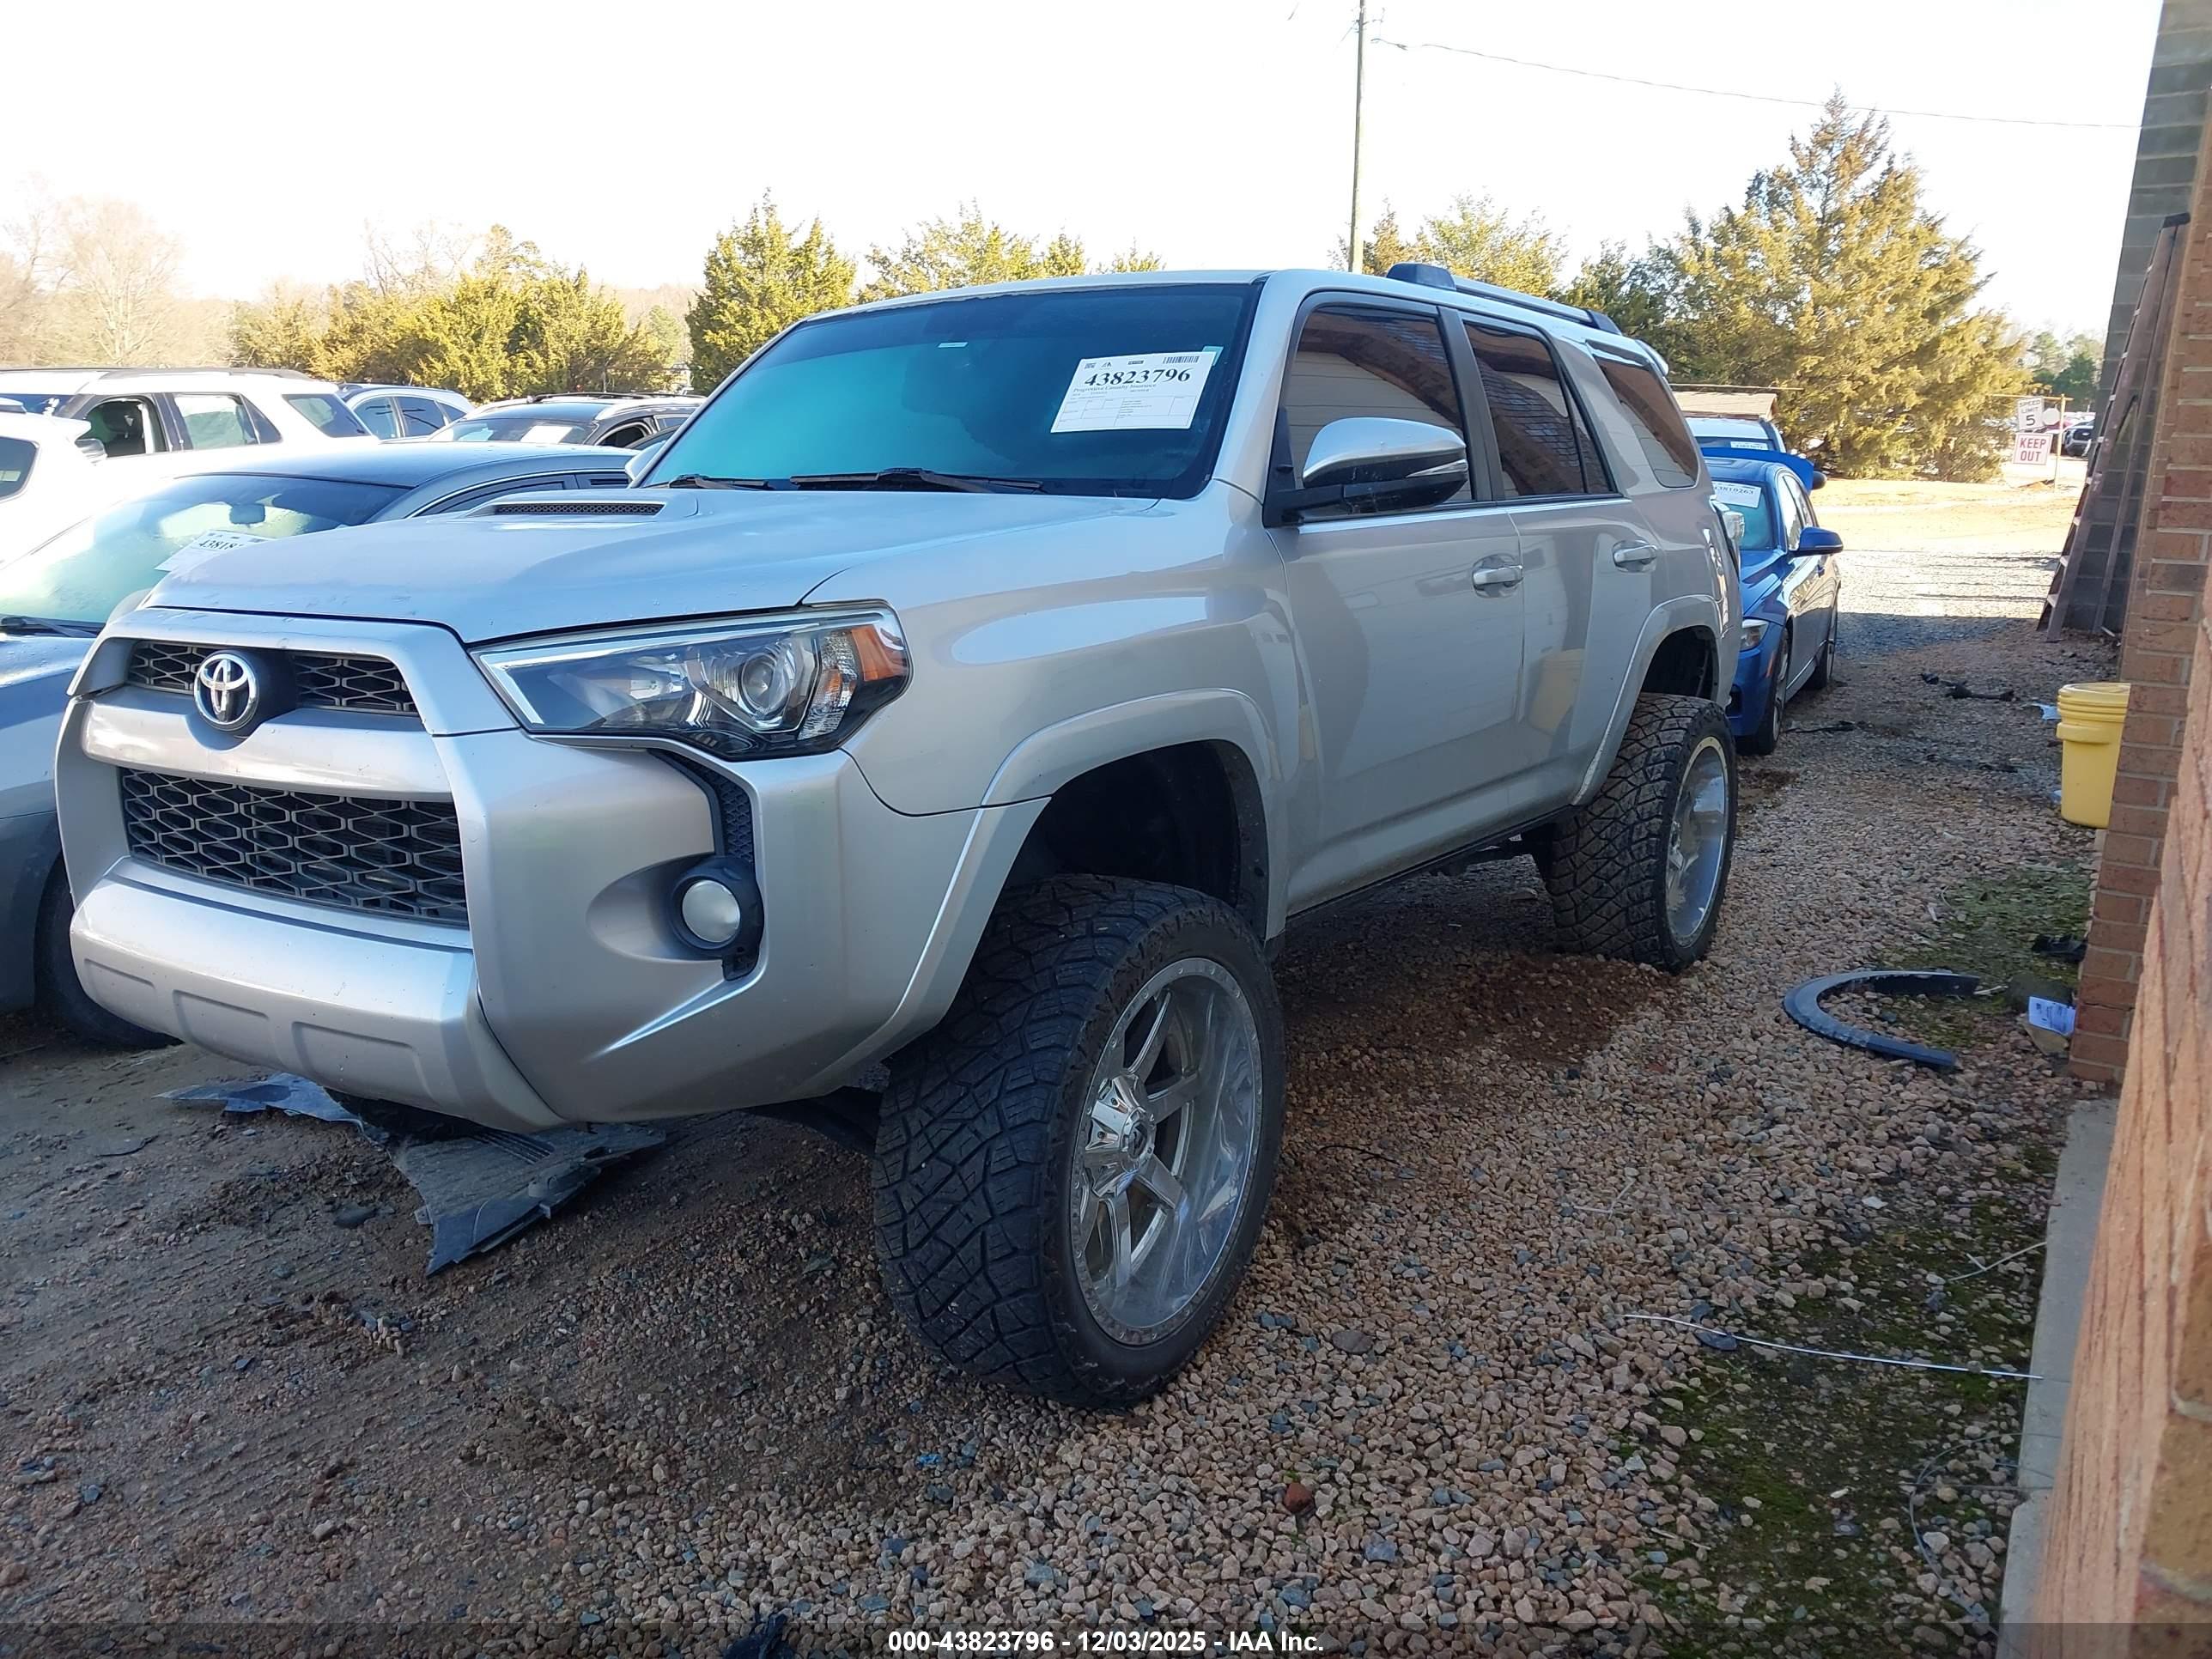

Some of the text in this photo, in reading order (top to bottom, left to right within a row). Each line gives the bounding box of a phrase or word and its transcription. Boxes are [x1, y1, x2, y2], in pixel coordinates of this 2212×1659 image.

[1084, 368, 1195, 386] 43823796
[2026, 414, 2036, 427] 5
[2020, 437, 2047, 449] KEEP
[2020, 450, 2042, 462] OUT
